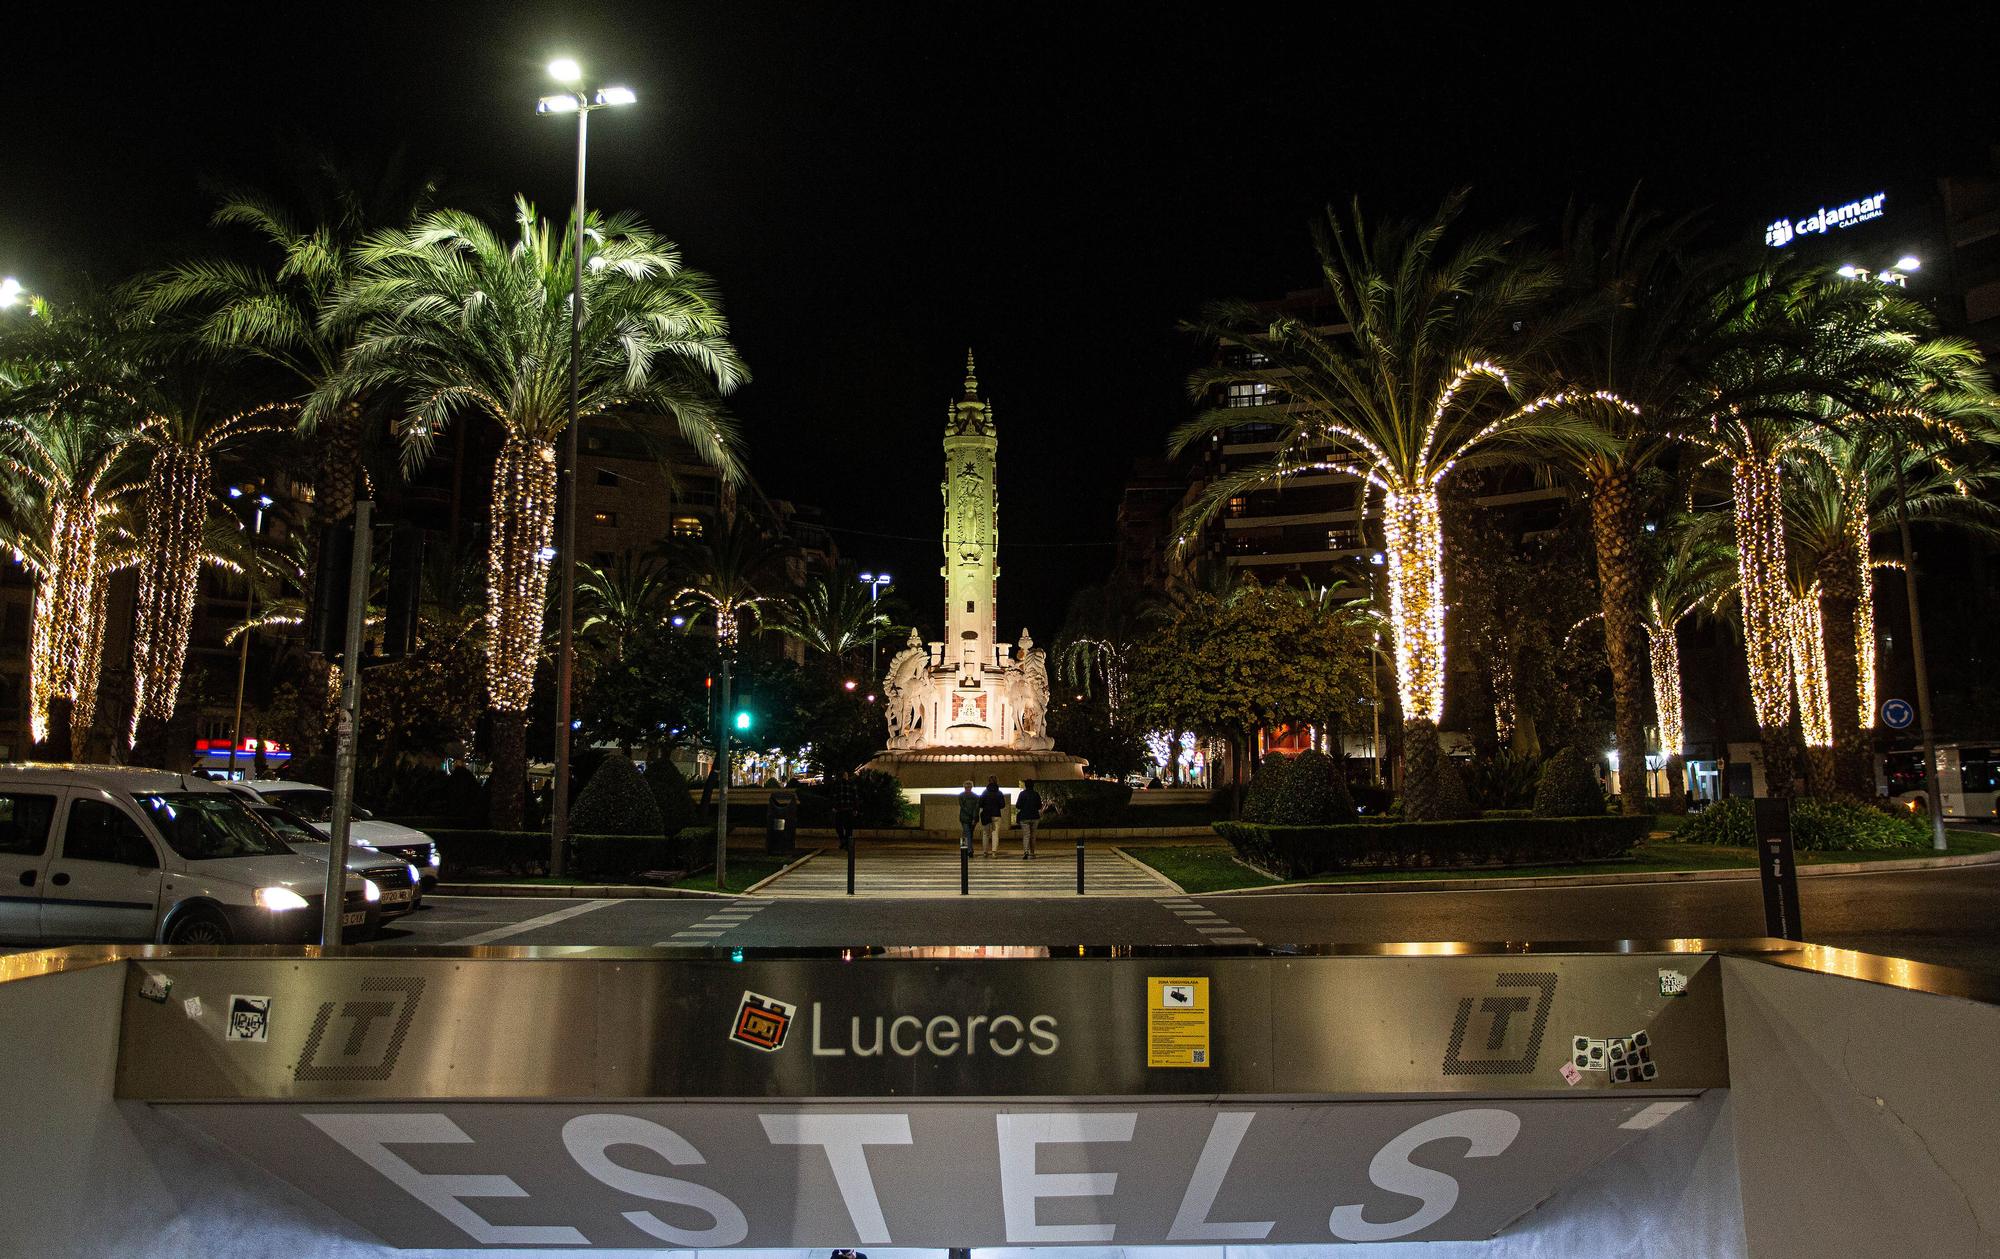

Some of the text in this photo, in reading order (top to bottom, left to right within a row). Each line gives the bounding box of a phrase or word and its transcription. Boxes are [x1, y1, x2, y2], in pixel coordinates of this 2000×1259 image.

[1795, 192, 1885, 234] cajamar
[1839, 210, 1884, 228] CAJA RURAL
[811, 1001, 1061, 1058] Luceros
[302, 1106, 1521, 1248] ESTELS
